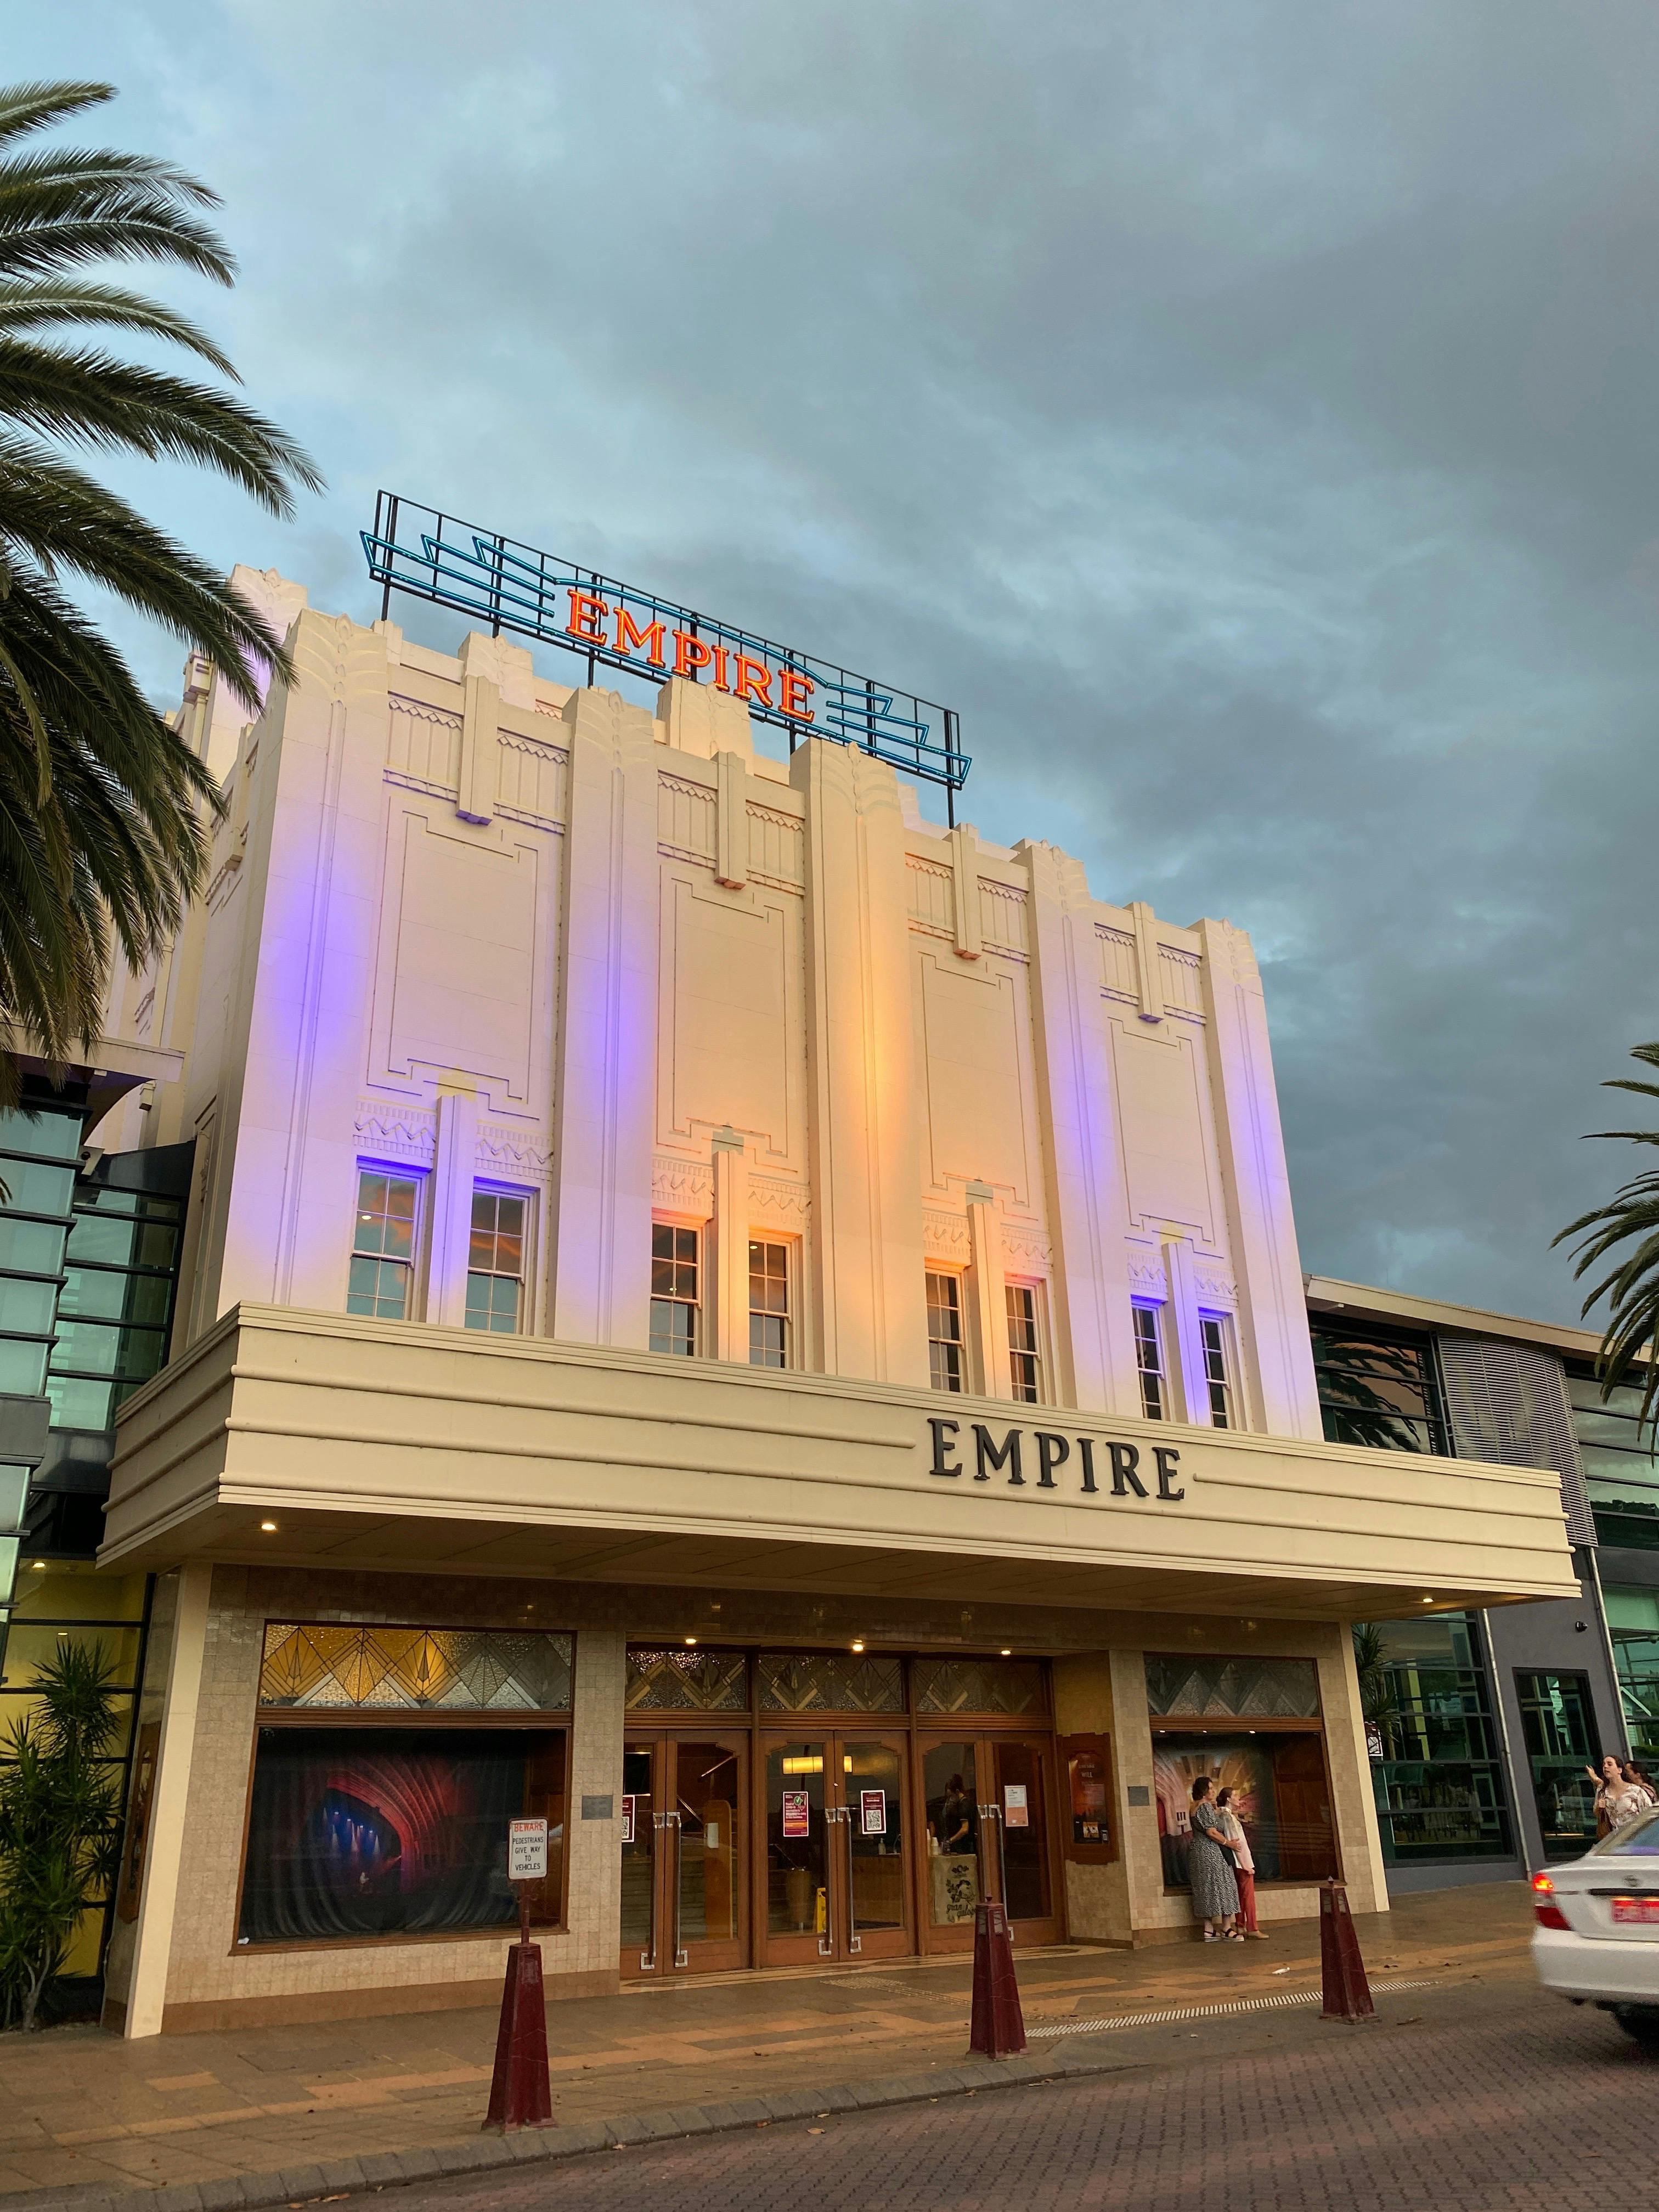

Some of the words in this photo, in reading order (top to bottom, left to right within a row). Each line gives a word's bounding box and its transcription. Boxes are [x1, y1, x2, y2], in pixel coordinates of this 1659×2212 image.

[566, 588, 815, 723] EMPIRE
[927, 1418, 1185, 1500] EMPIRE
[514, 1822, 544, 1832] BEWARE
